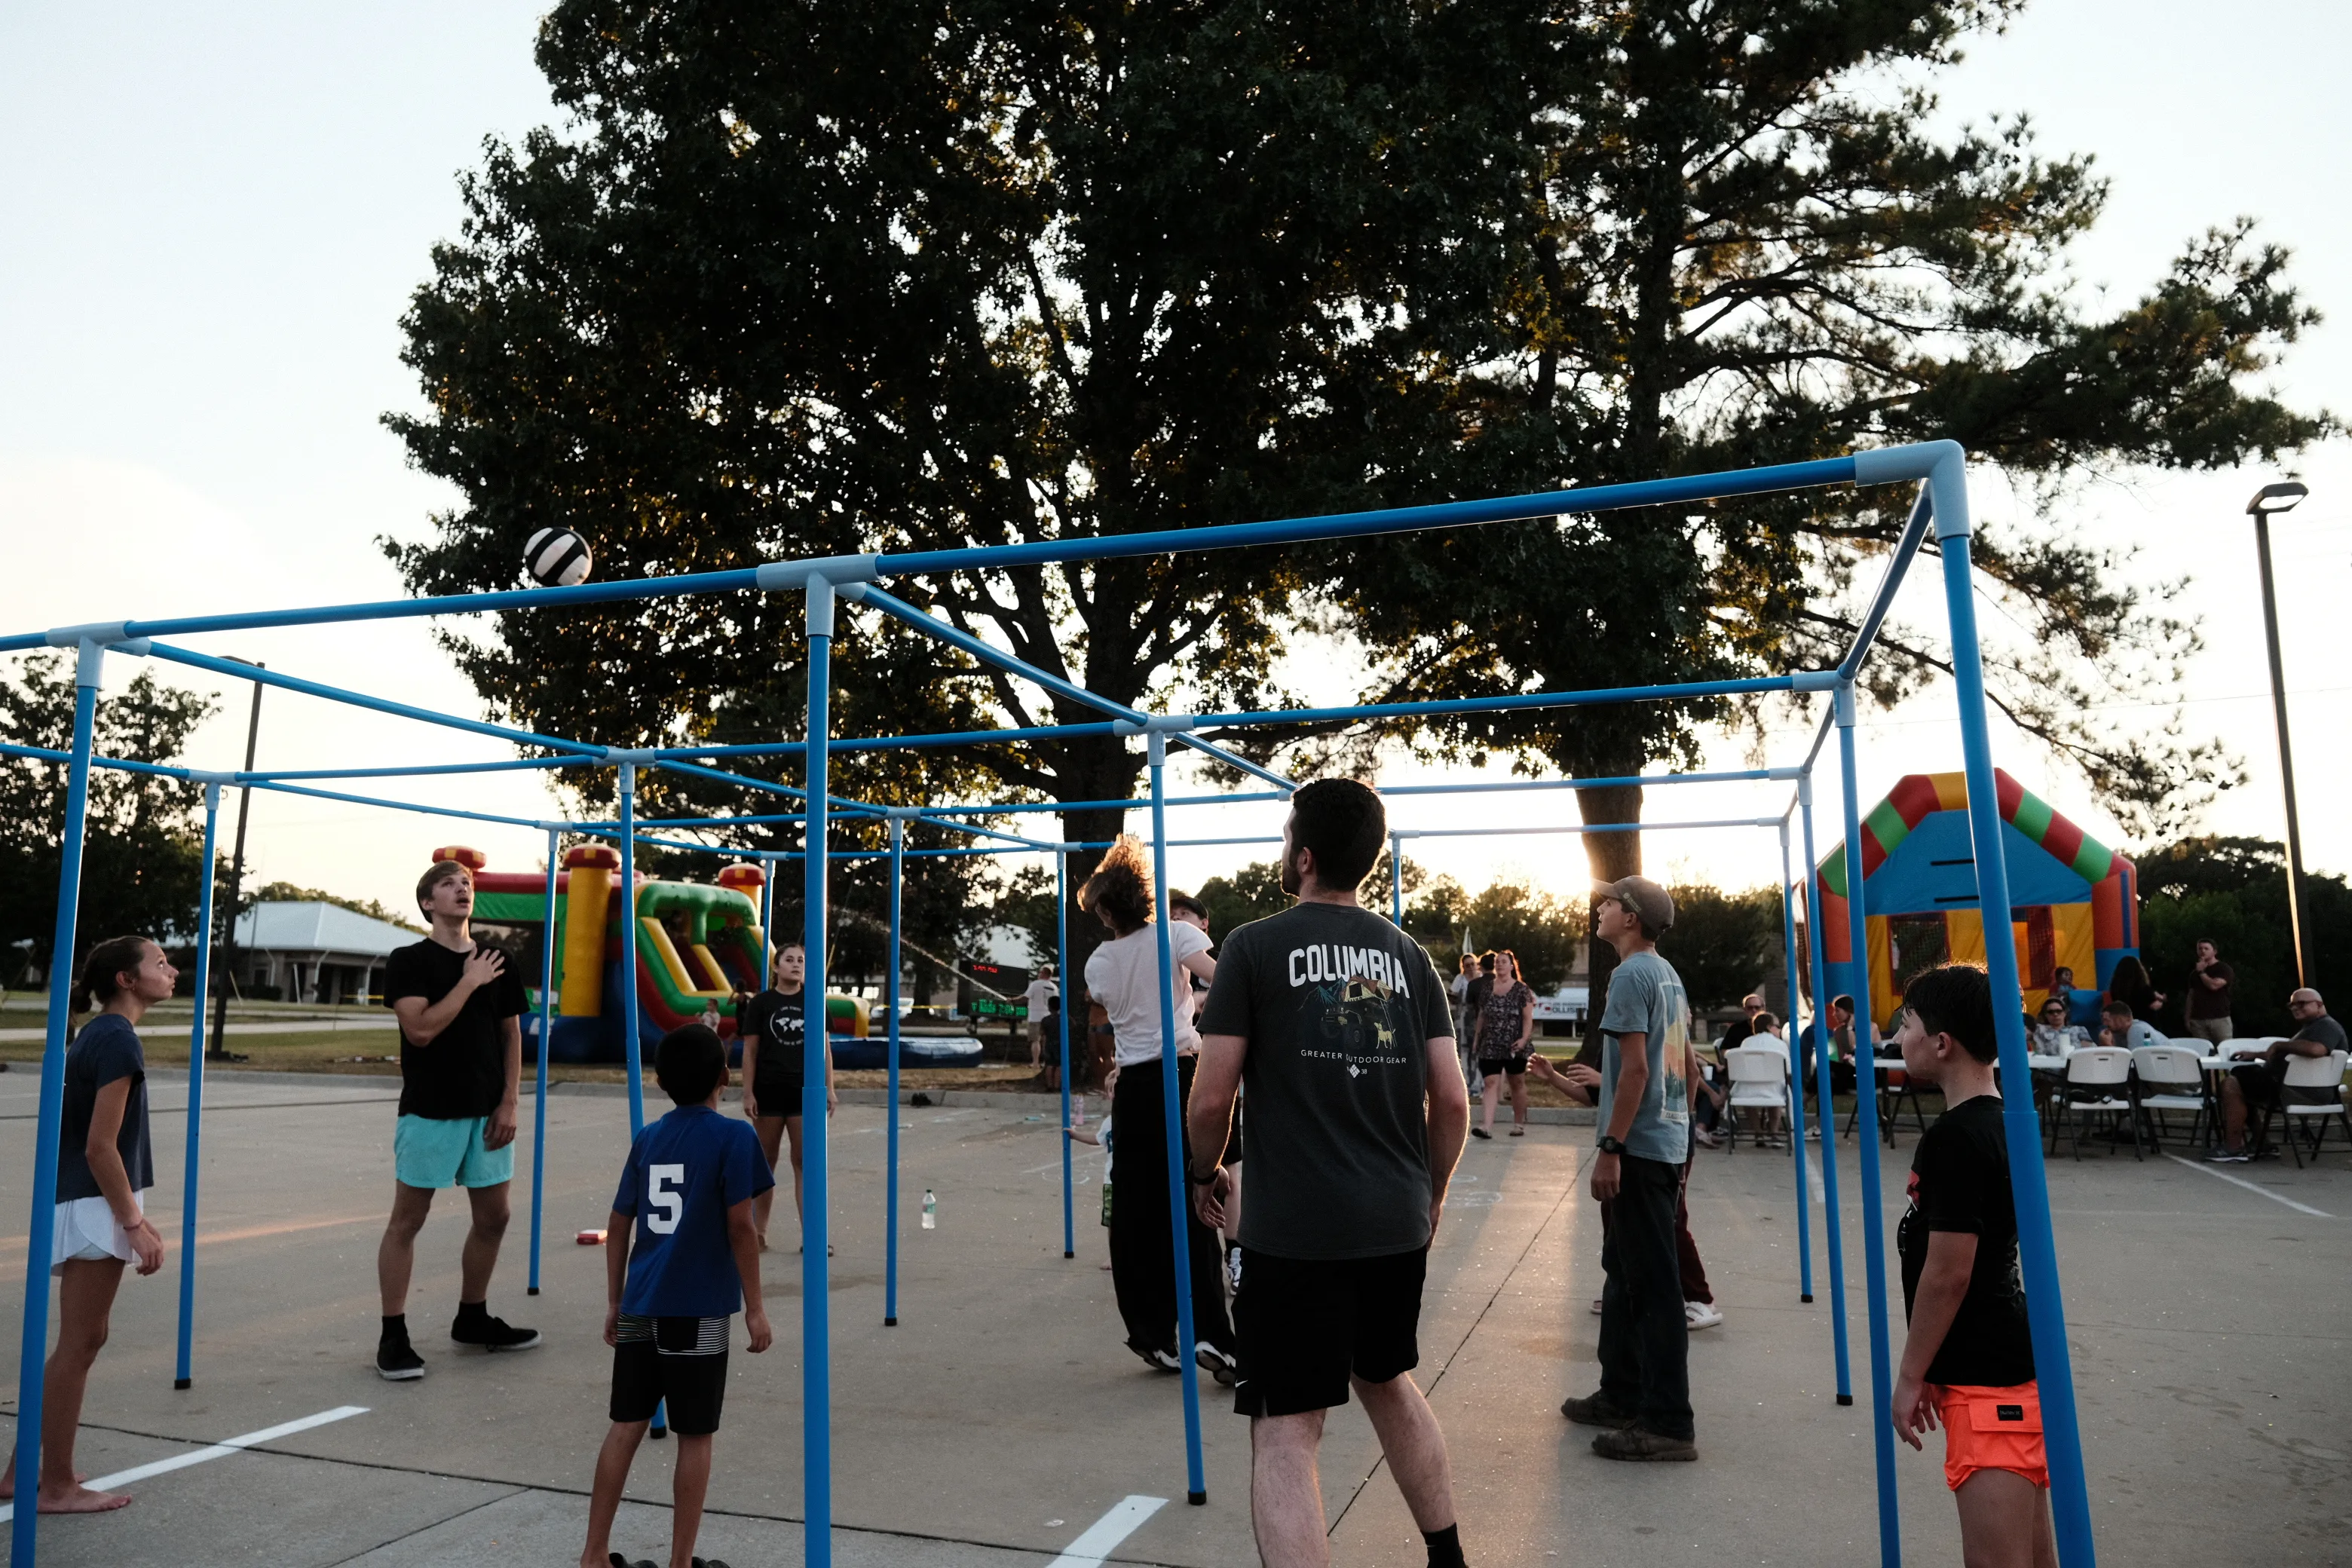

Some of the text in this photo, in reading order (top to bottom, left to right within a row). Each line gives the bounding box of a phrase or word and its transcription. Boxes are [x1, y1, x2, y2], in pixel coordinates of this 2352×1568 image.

[1288, 944, 1410, 999] COLUMBIA
[1300, 1049, 1343, 1060] GREATER
[1346, 1053, 1384, 1064] OUTDOOR
[648, 1163, 684, 1235] 5
